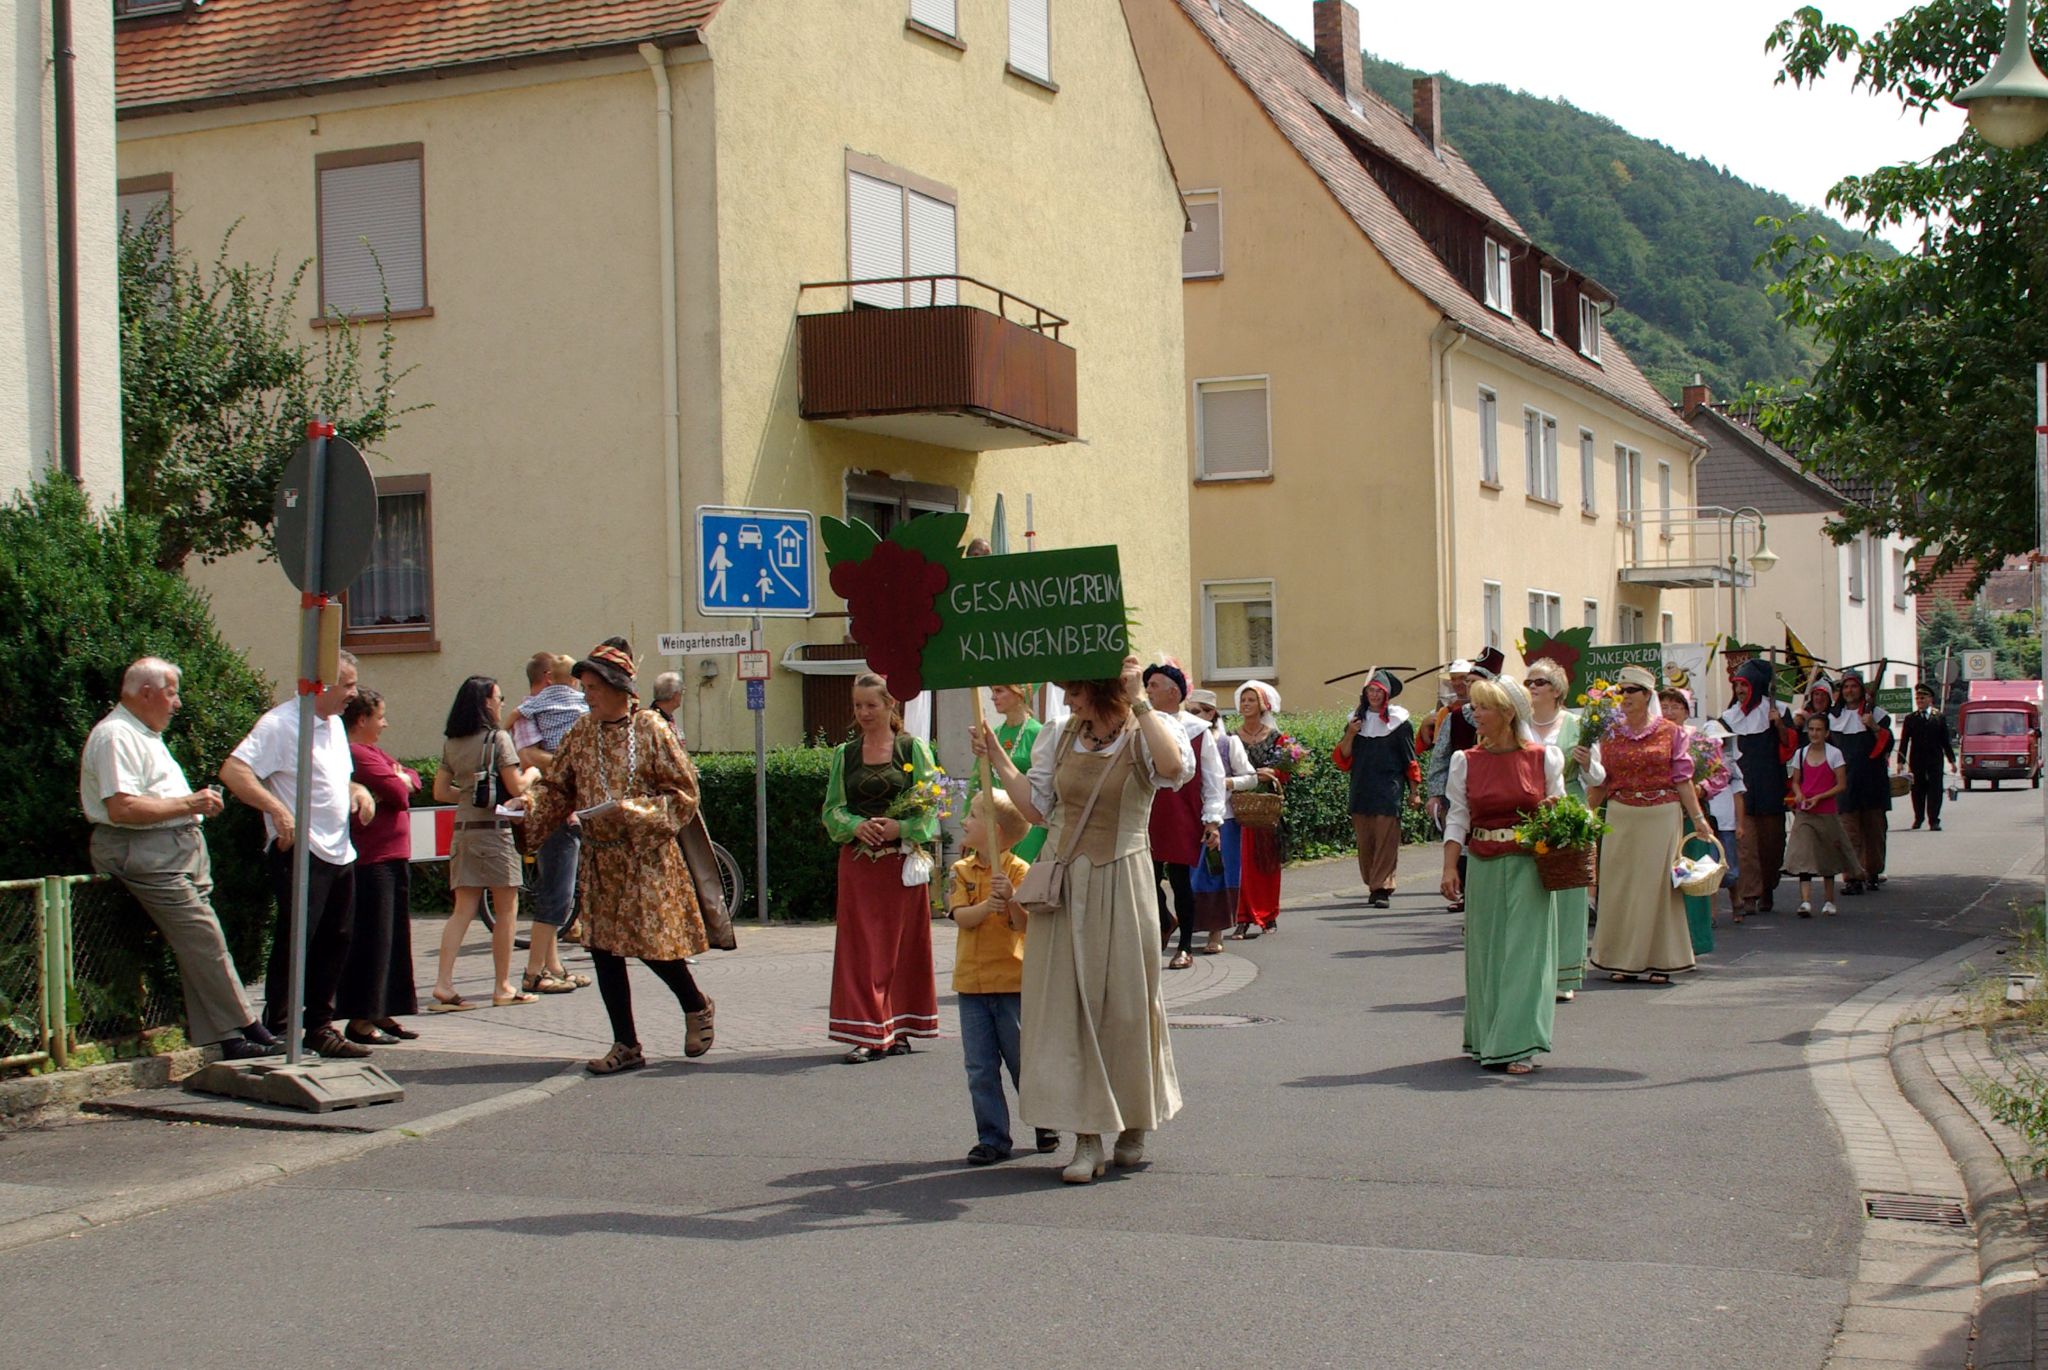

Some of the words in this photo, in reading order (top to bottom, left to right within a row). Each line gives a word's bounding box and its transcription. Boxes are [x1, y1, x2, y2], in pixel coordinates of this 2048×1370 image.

[951, 573, 1122, 614] GESANGVEREIN
[662, 633, 747, 652] Weingartenstraße
[959, 624, 1125, 662] KLINGENBERG
